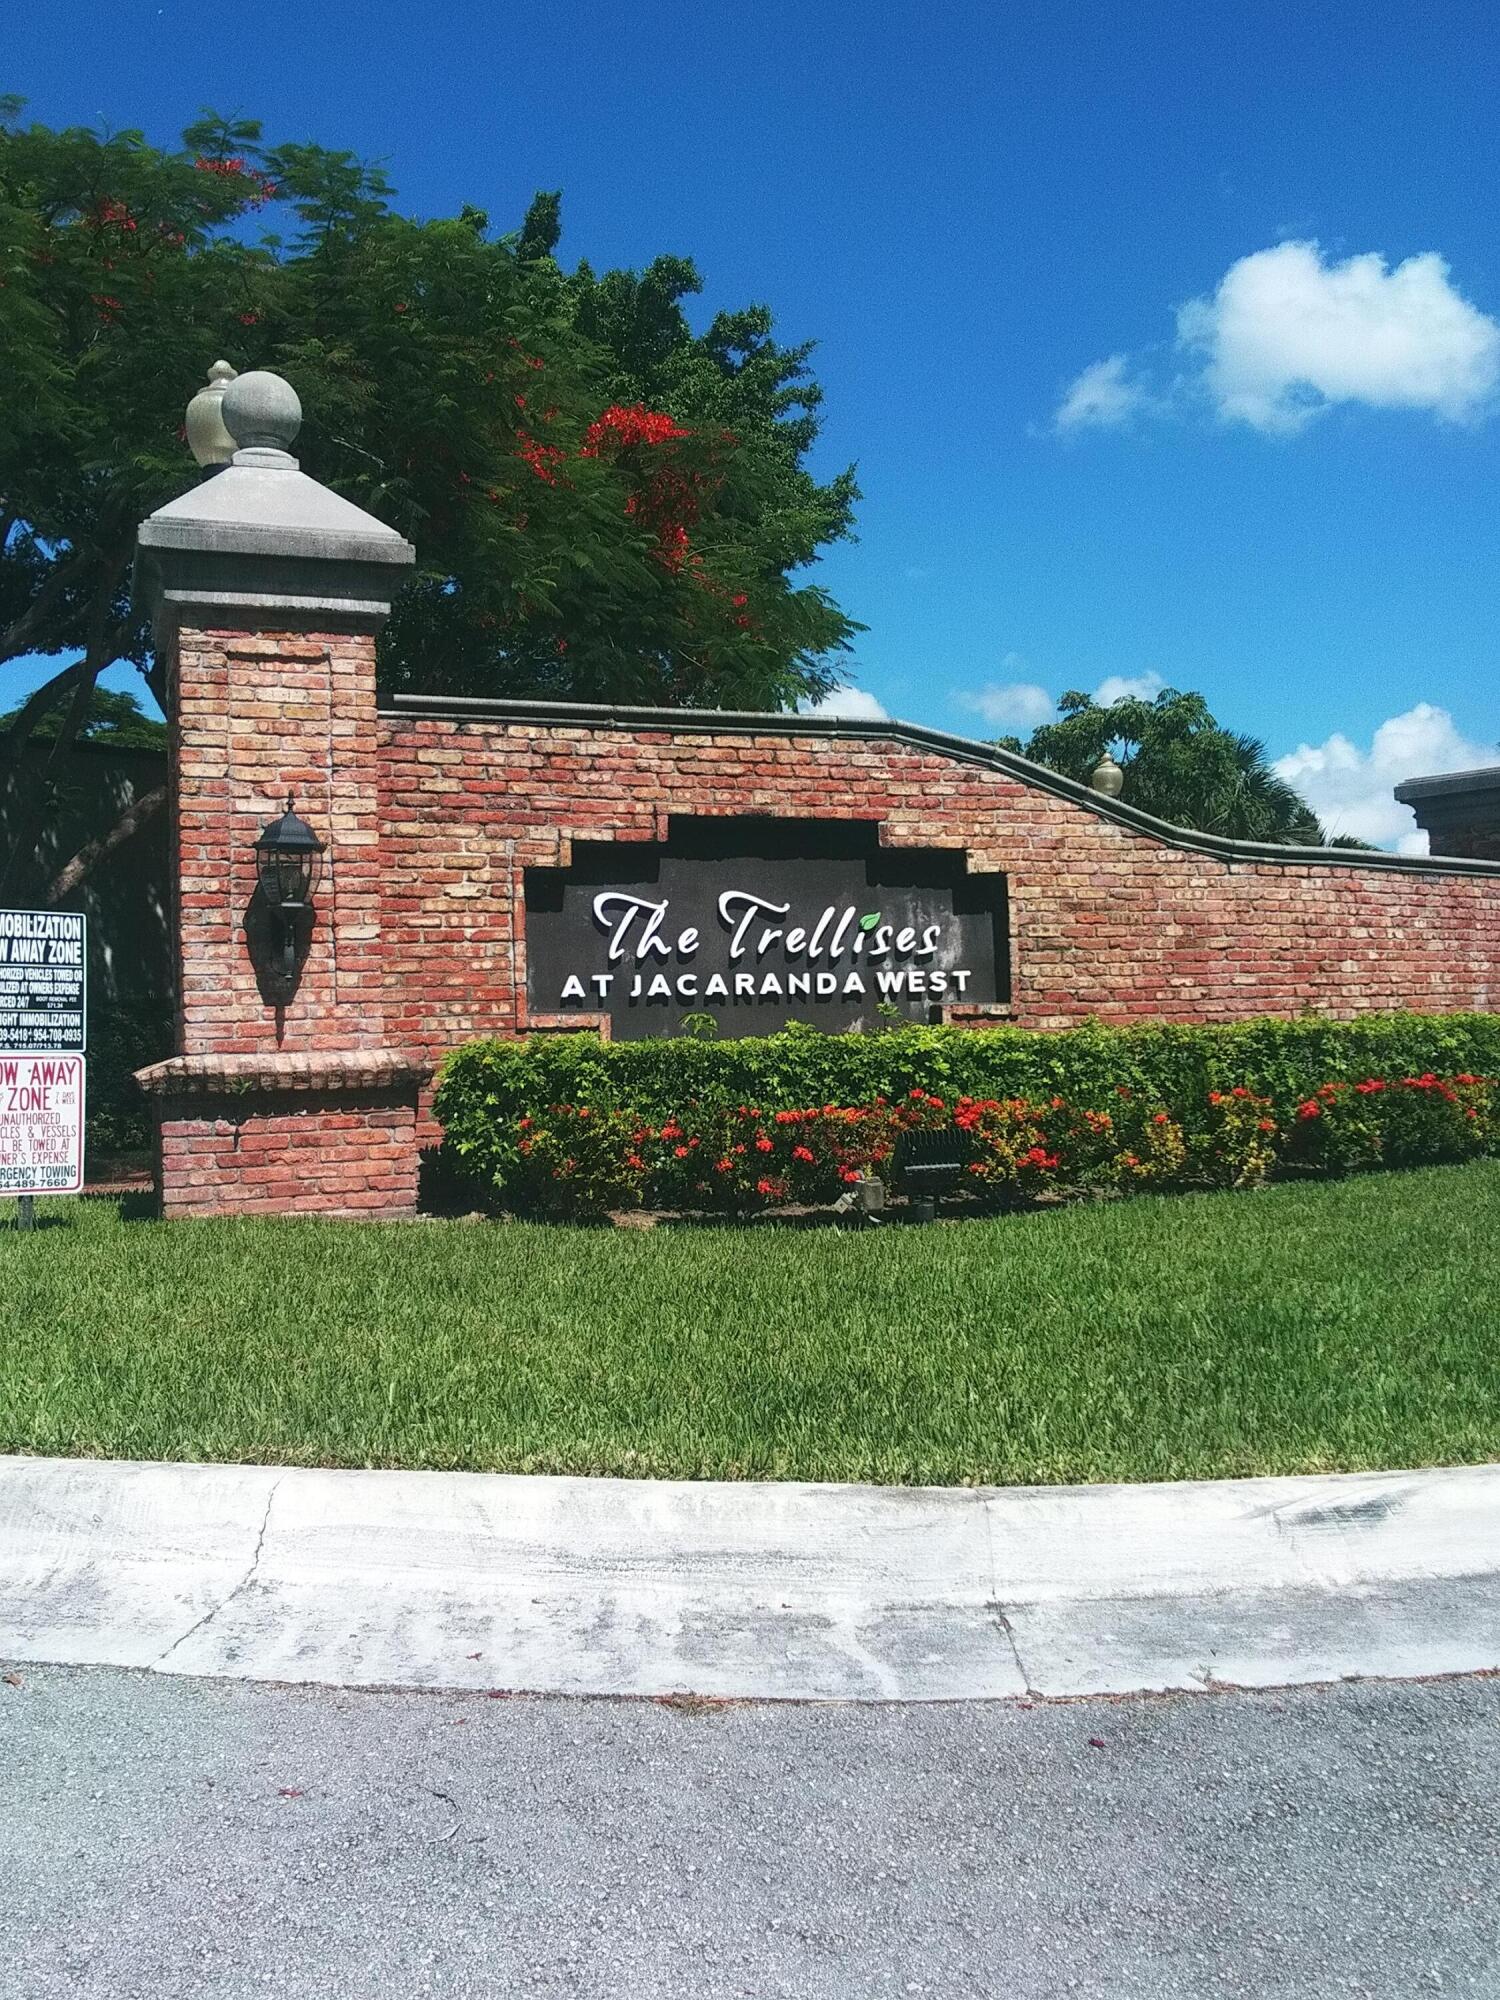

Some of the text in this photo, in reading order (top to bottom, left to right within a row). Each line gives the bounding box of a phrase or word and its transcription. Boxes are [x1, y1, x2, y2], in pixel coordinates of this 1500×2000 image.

[593, 890, 941, 959] The Trellises
[10, 940, 46, 962] AWAY
[48, 941, 82, 964] ZONE
[25, 968, 53, 981] VEHICLES
[53, 969, 73, 981] TOWED
[74, 970, 83, 982] OR
[0, 981, 80, 995] ILIZED AT OWNERS EXPENSE
[561, 970, 972, 998] AT JACARANDA WEST
[19, 1013, 80, 1027] IMMOBILIZATION
[30, 1062, 76, 1086] AWAY
[7, 1087, 52, 1111] ZONE
[0, 1112, 61, 1126] UNAUTHORIZED
[27, 1126, 35, 1139] &
[41, 1125, 77, 1138] VESSELS
[12, 1140, 23, 1152] BE
[29, 1139, 57, 1152] TOWED
[61, 1138, 70, 1151] AT
[0, 1151, 69, 1166] NER'S EXPENSE
[41, 1164, 77, 1179] TOWING
